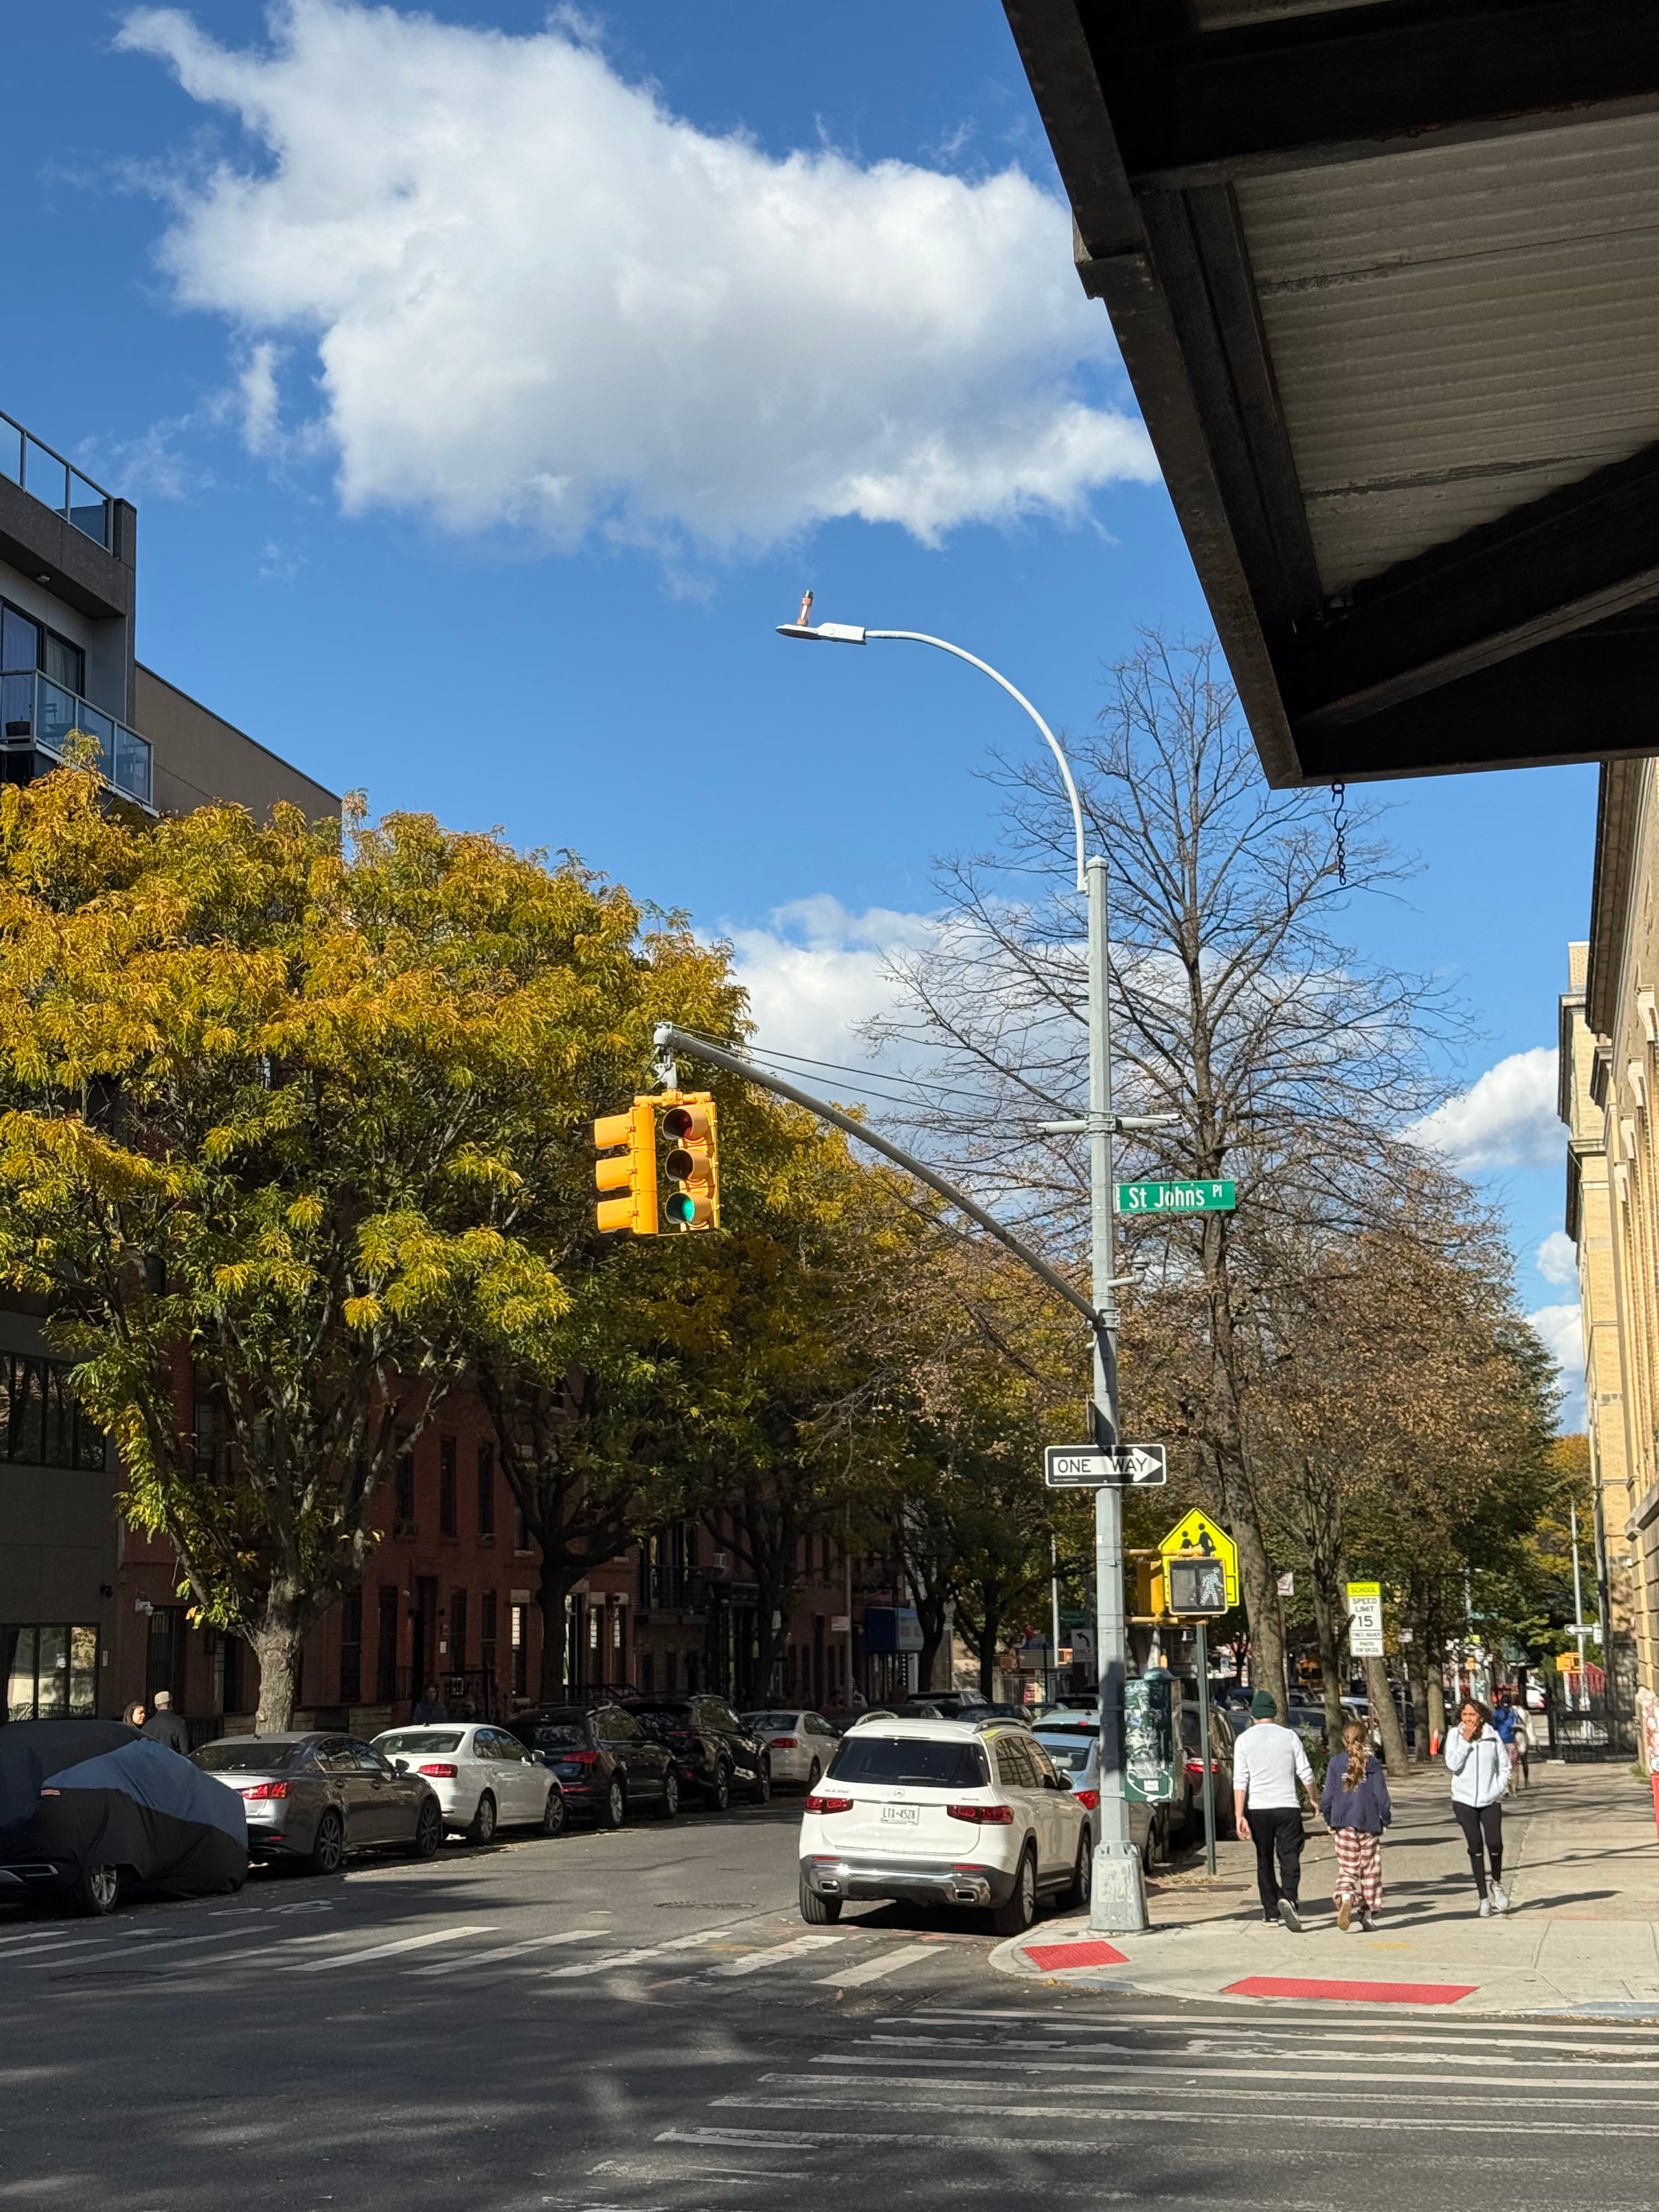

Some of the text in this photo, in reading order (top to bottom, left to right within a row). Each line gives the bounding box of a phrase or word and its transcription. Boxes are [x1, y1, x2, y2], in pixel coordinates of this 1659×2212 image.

[1128, 1186, 1147, 1209] St
[1212, 1184, 1222, 1198] Pl
[1058, 1457, 1148, 1473] ONE WAY
[1358, 1615, 1373, 1627] 15
